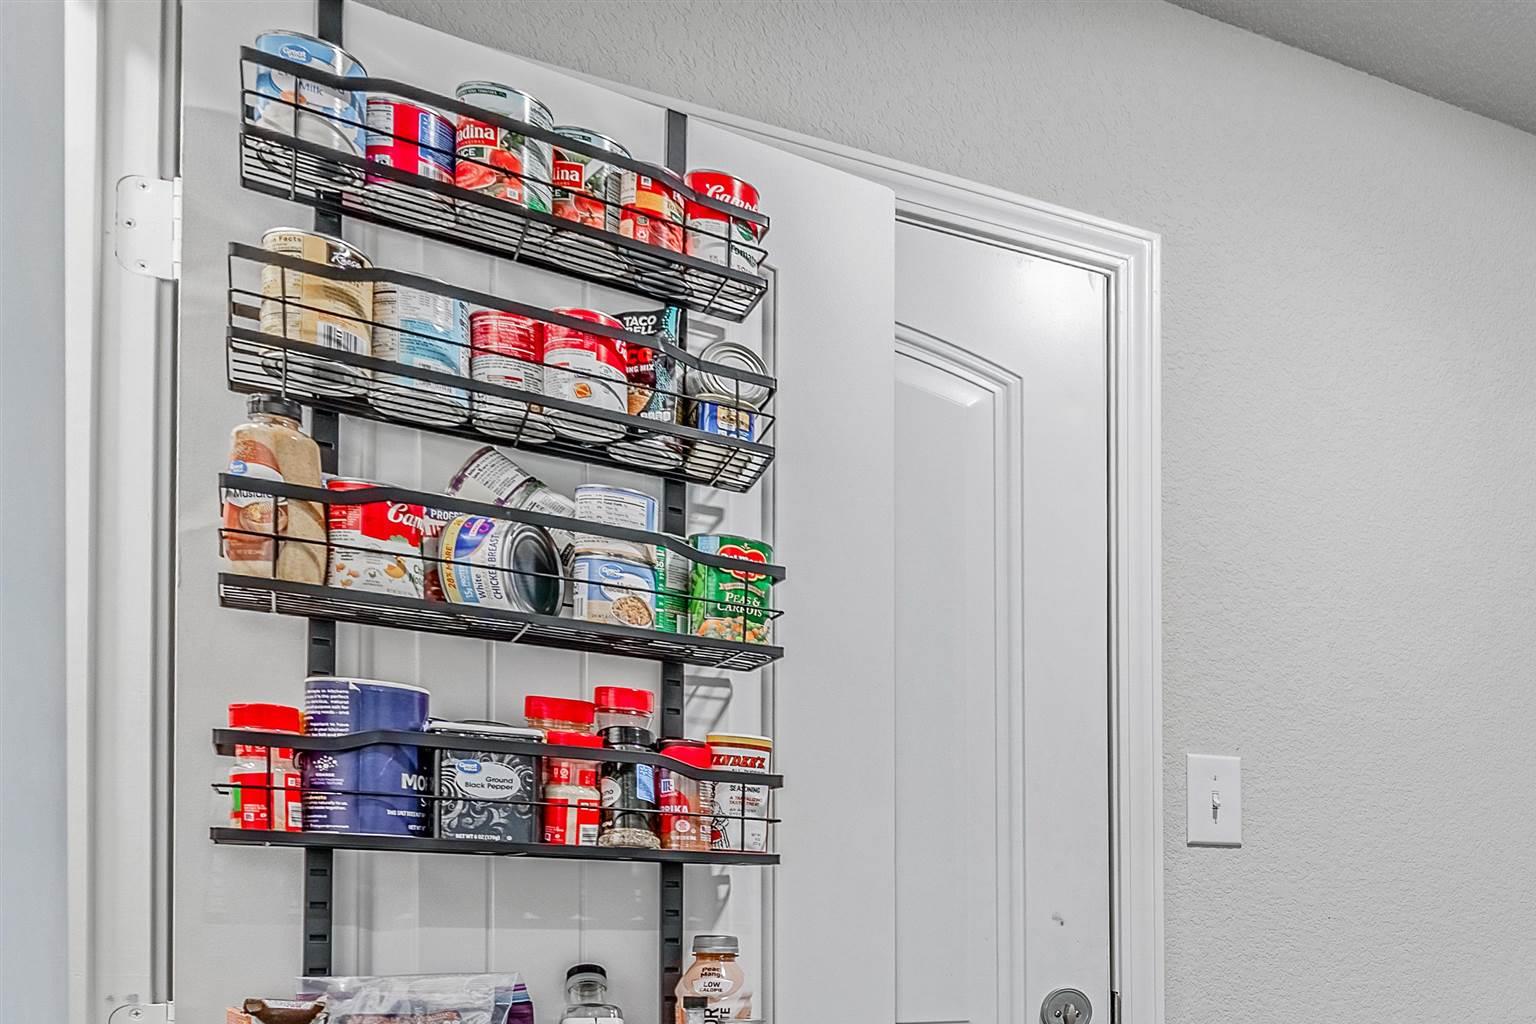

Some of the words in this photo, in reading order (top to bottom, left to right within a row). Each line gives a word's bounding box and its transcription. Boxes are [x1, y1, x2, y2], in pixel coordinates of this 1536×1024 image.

[623, 315, 657, 328] TACO
[640, 363, 654, 372] MIX
[486, 533, 501, 563] BREAST
[474, 573, 487, 598] White
[487, 563, 503, 600] CHICKEN
[725, 592, 752, 605] PEAS
[752, 597, 761, 607] &
[485, 776, 514, 784] Ground
[729, 784, 761, 794] SEAONING
